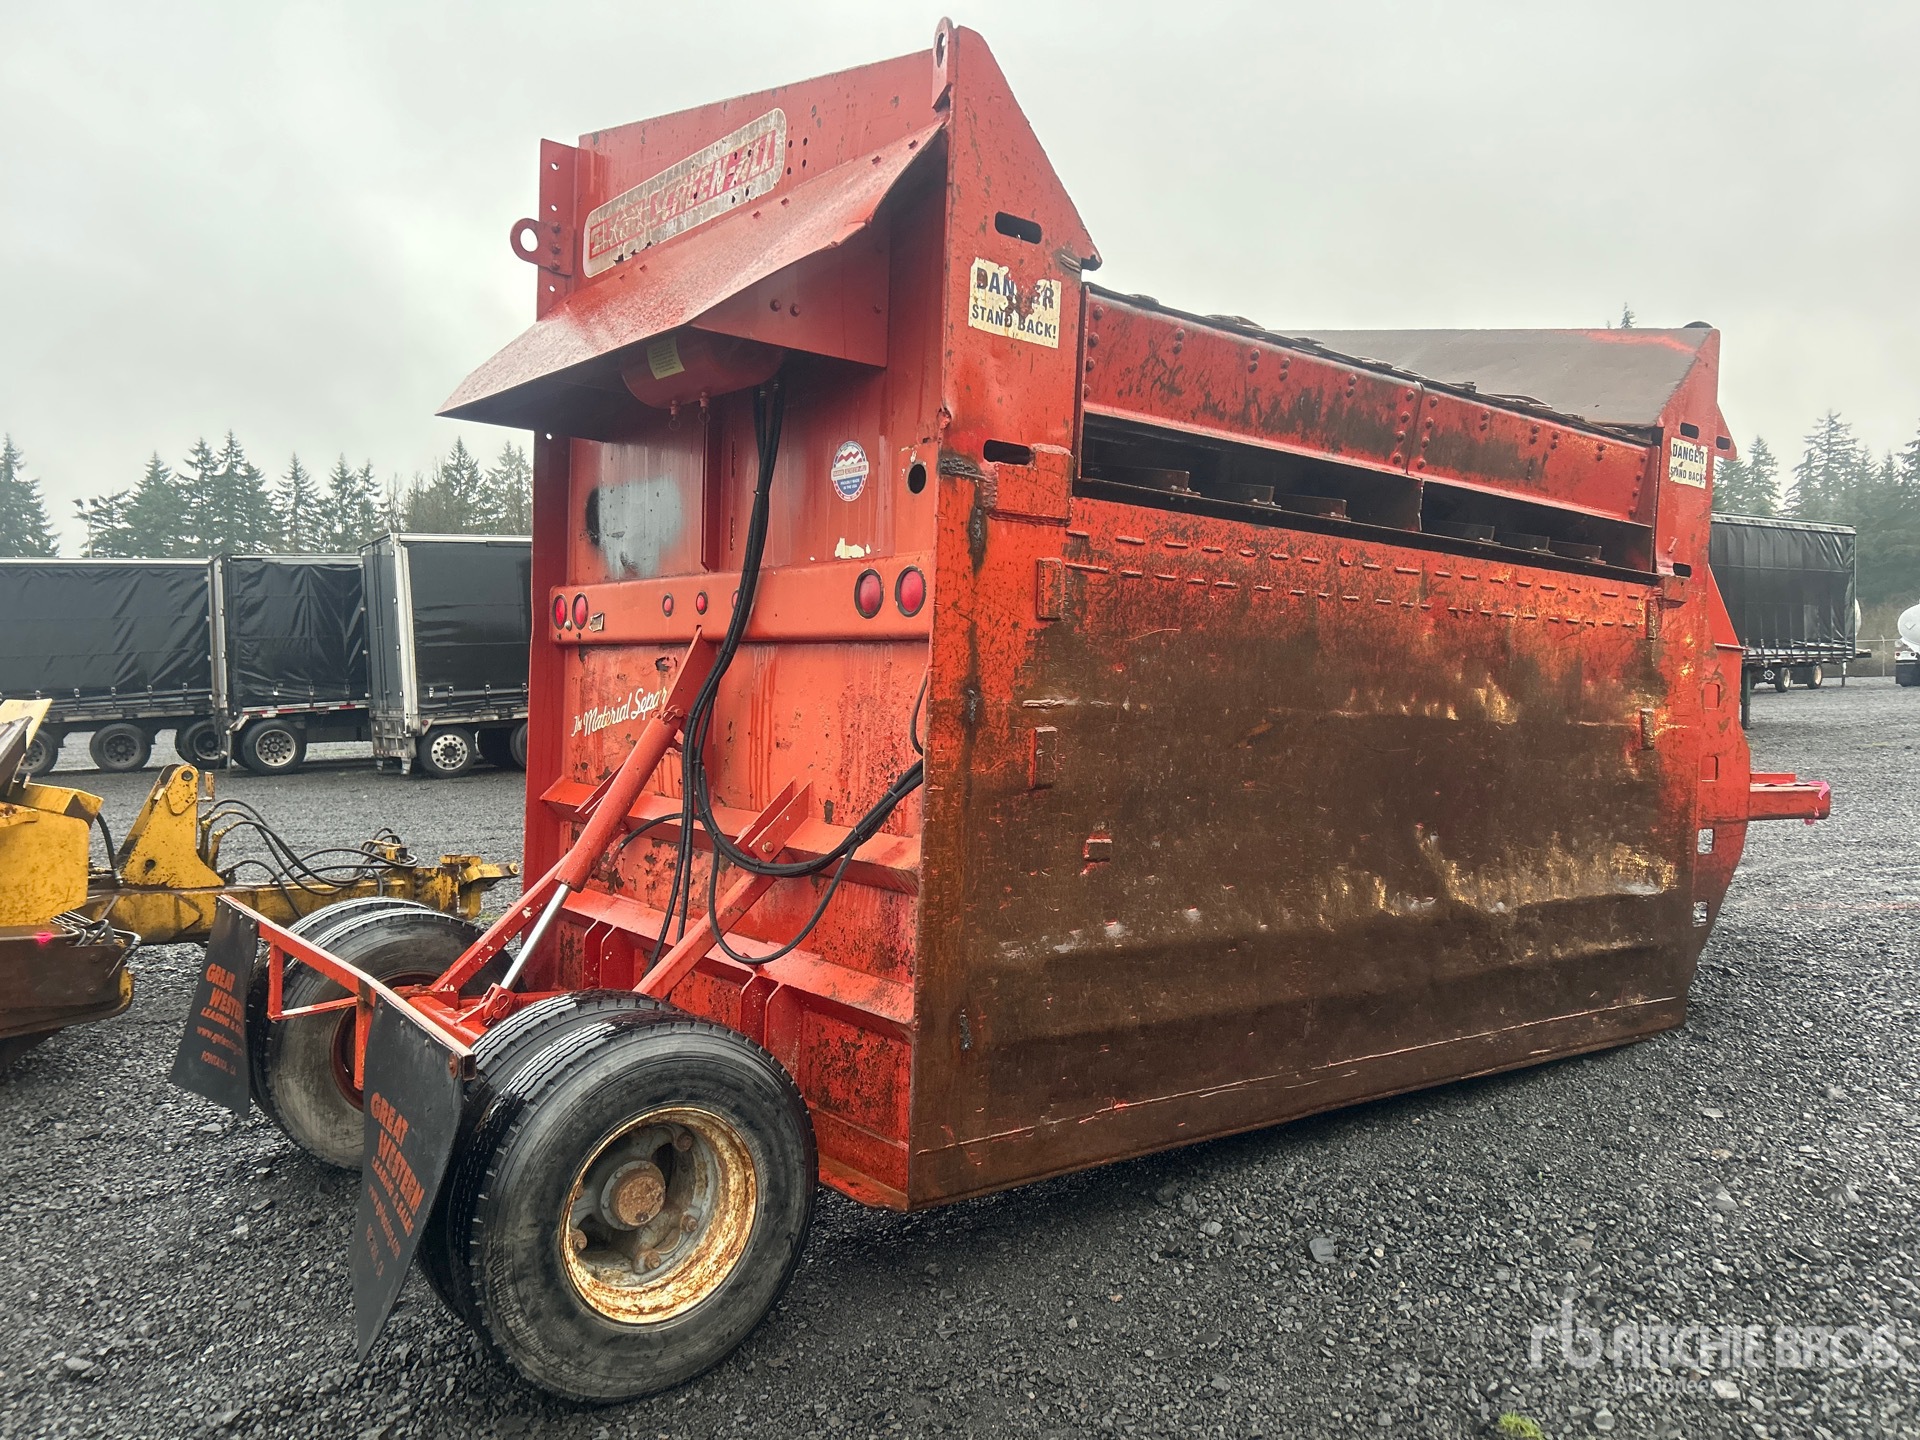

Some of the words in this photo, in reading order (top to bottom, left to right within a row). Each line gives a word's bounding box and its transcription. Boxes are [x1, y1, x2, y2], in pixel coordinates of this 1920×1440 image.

[972, 304, 1013, 328] STAND
[1018, 317, 1056, 339] BACK!
[1673, 444, 1704, 464] DANGER
[583, 692, 633, 737] Material
[206, 963, 236, 992] GREAT
[200, 1007, 231, 1027] LEASING
[370, 1091, 409, 1147] GREAT
[371, 1156, 395, 1198] LEASING
[378, 1129, 425, 1216] WESTERN
